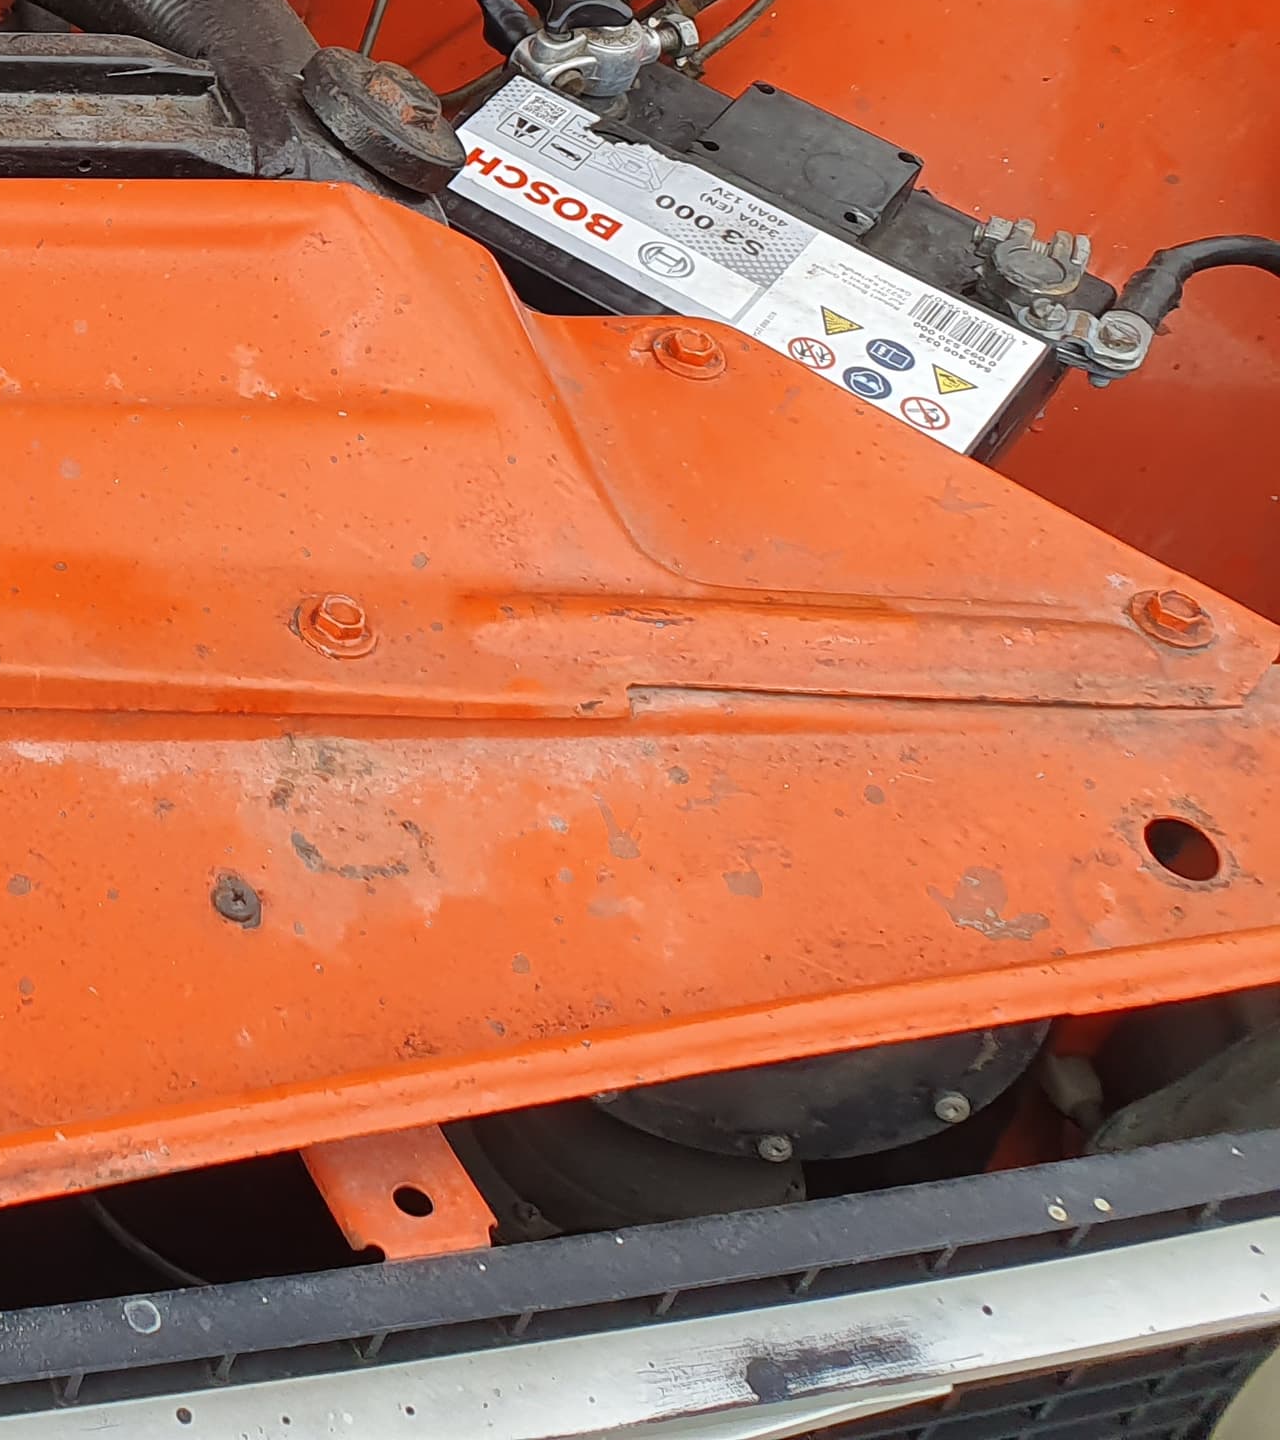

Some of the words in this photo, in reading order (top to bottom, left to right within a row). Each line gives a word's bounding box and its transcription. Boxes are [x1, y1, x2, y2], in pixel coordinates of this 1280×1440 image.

[465, 147, 623, 241] BOSCH
[699, 192, 735, 215] (EN)
[711, 187, 744, 205] 12V
[655, 194, 715, 230] 000
[739, 212, 780, 238] 340A
[747, 203, 789, 228] 40Ah
[720, 229, 765, 257] S3
